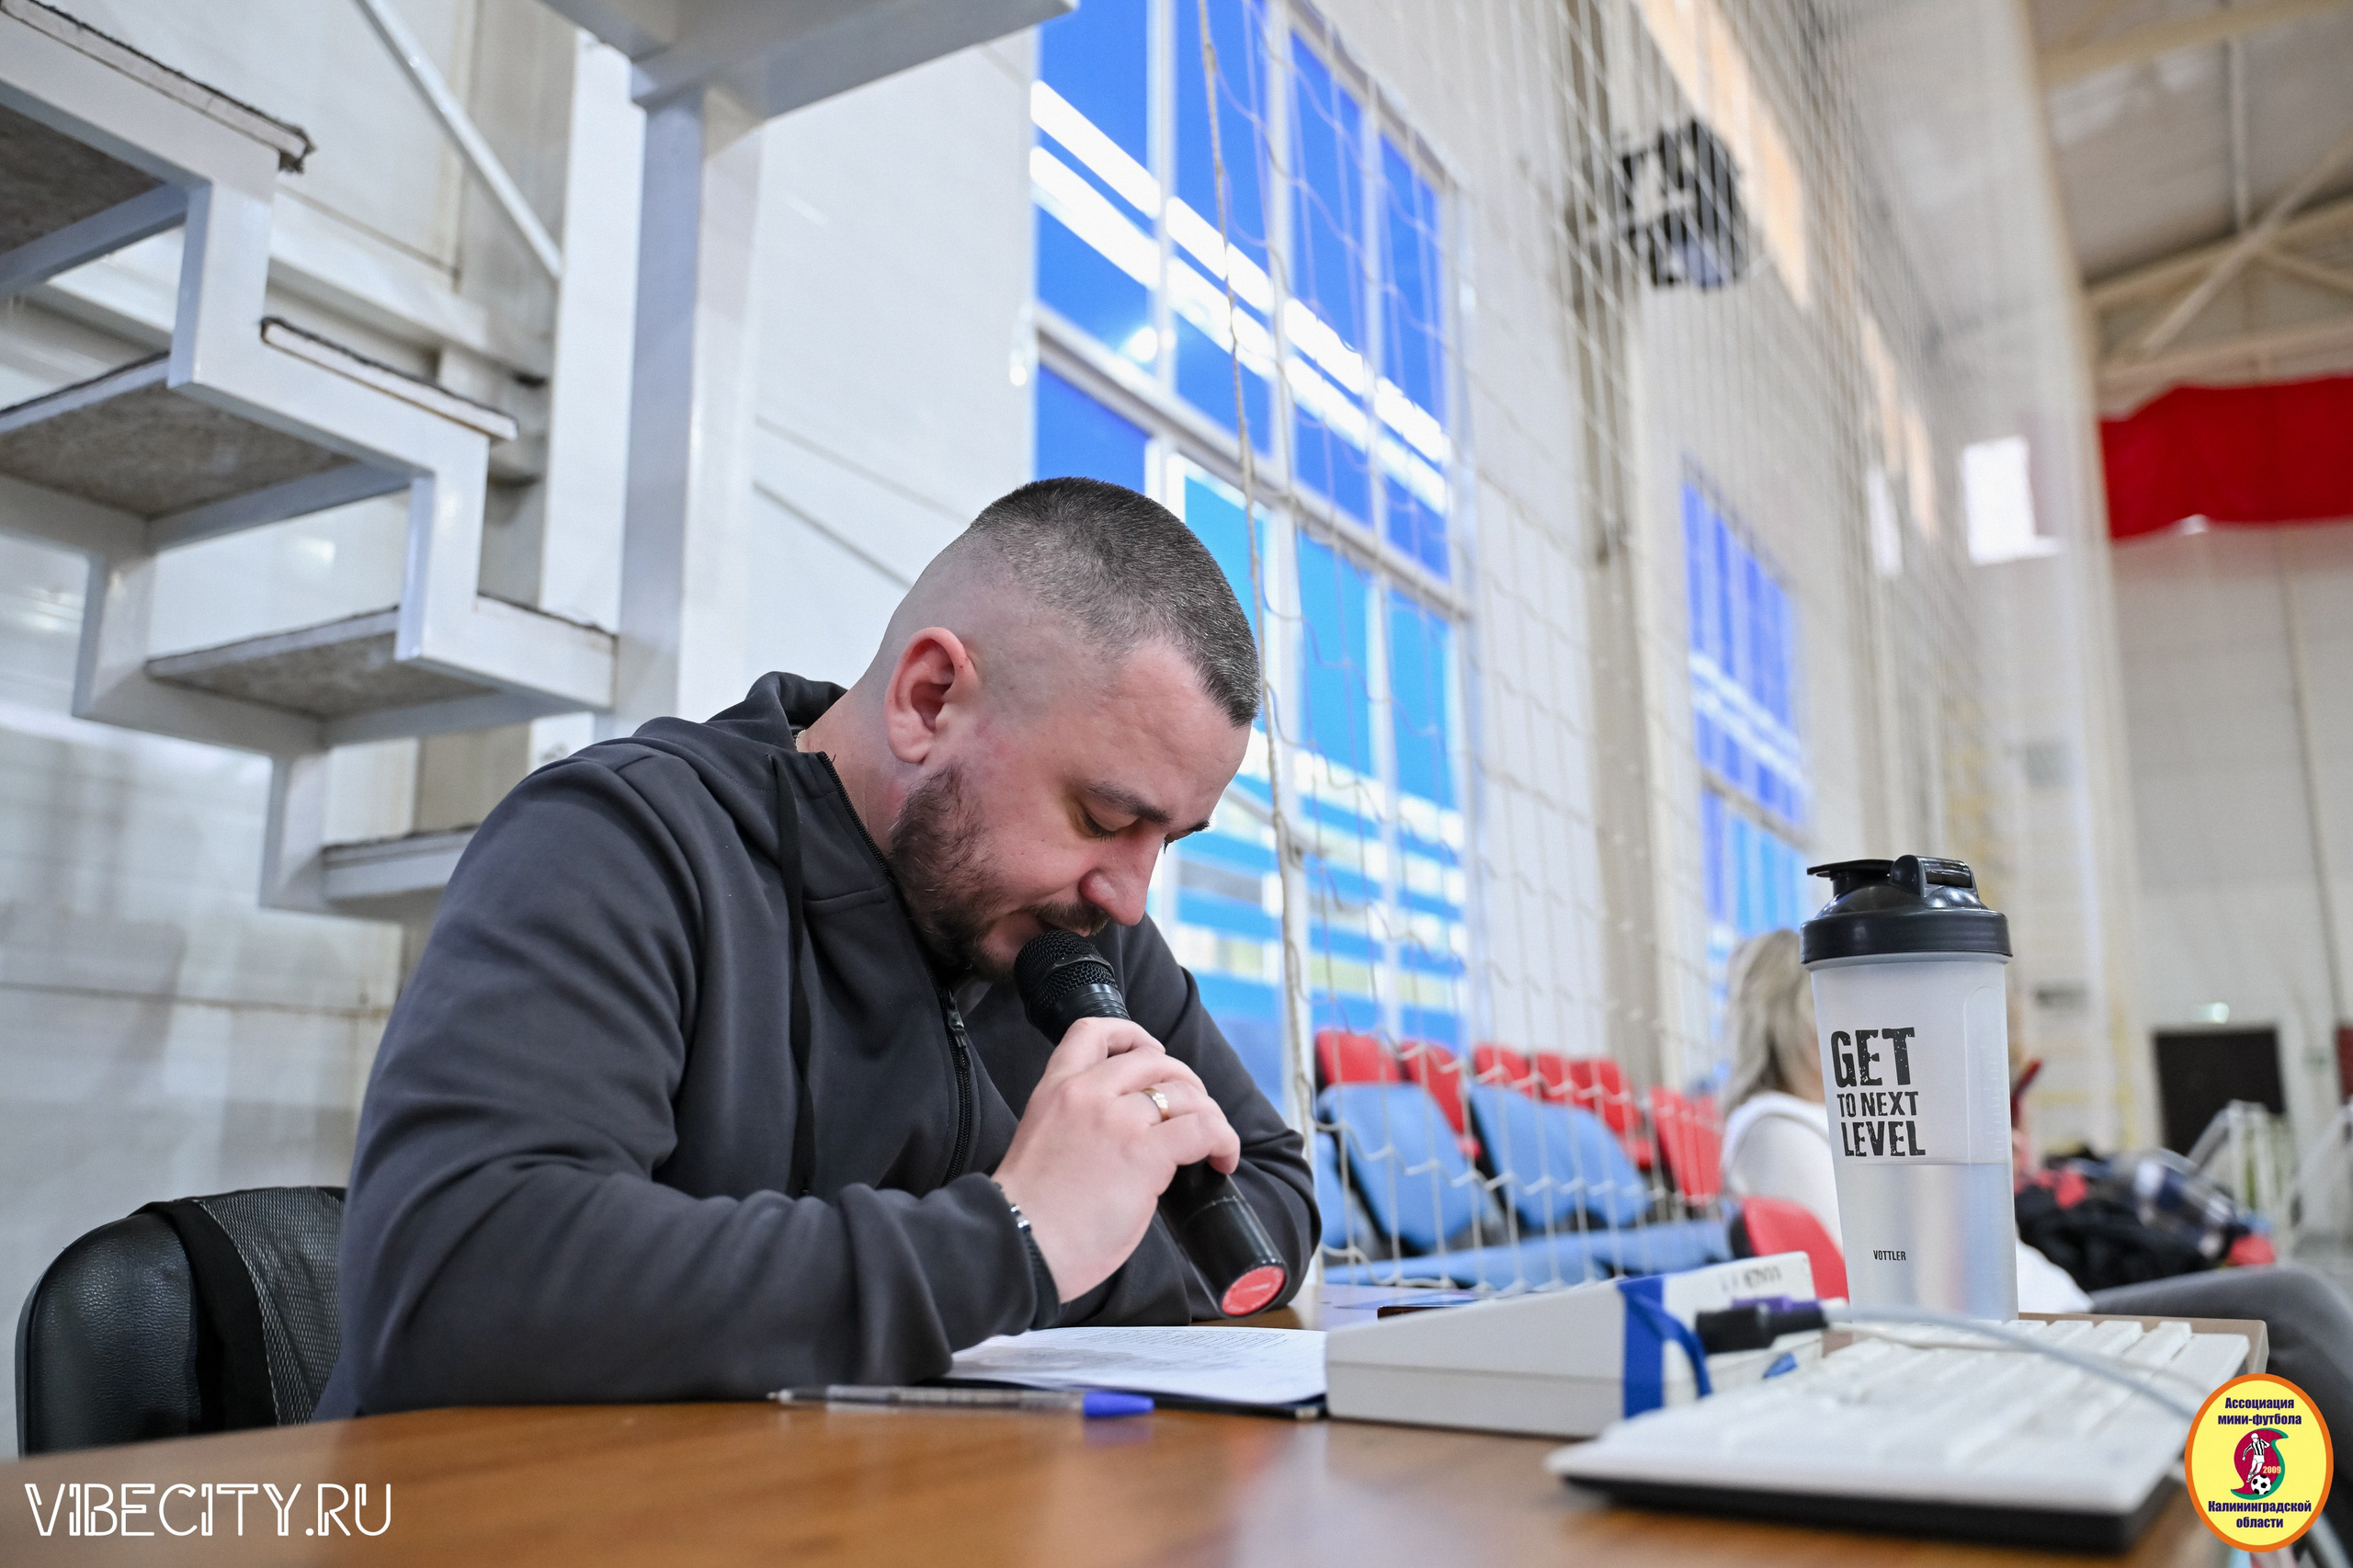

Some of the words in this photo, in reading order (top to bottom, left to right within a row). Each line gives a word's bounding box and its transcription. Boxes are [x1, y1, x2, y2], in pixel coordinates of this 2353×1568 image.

[1831, 1027, 1915, 1088] GET
[1836, 1092, 1857, 1118] TO
[1861, 1091, 1919, 1117] NEXT
[1840, 1120, 1927, 1157] LEVEL
[1872, 1249, 1907, 1262] VOTTLER
